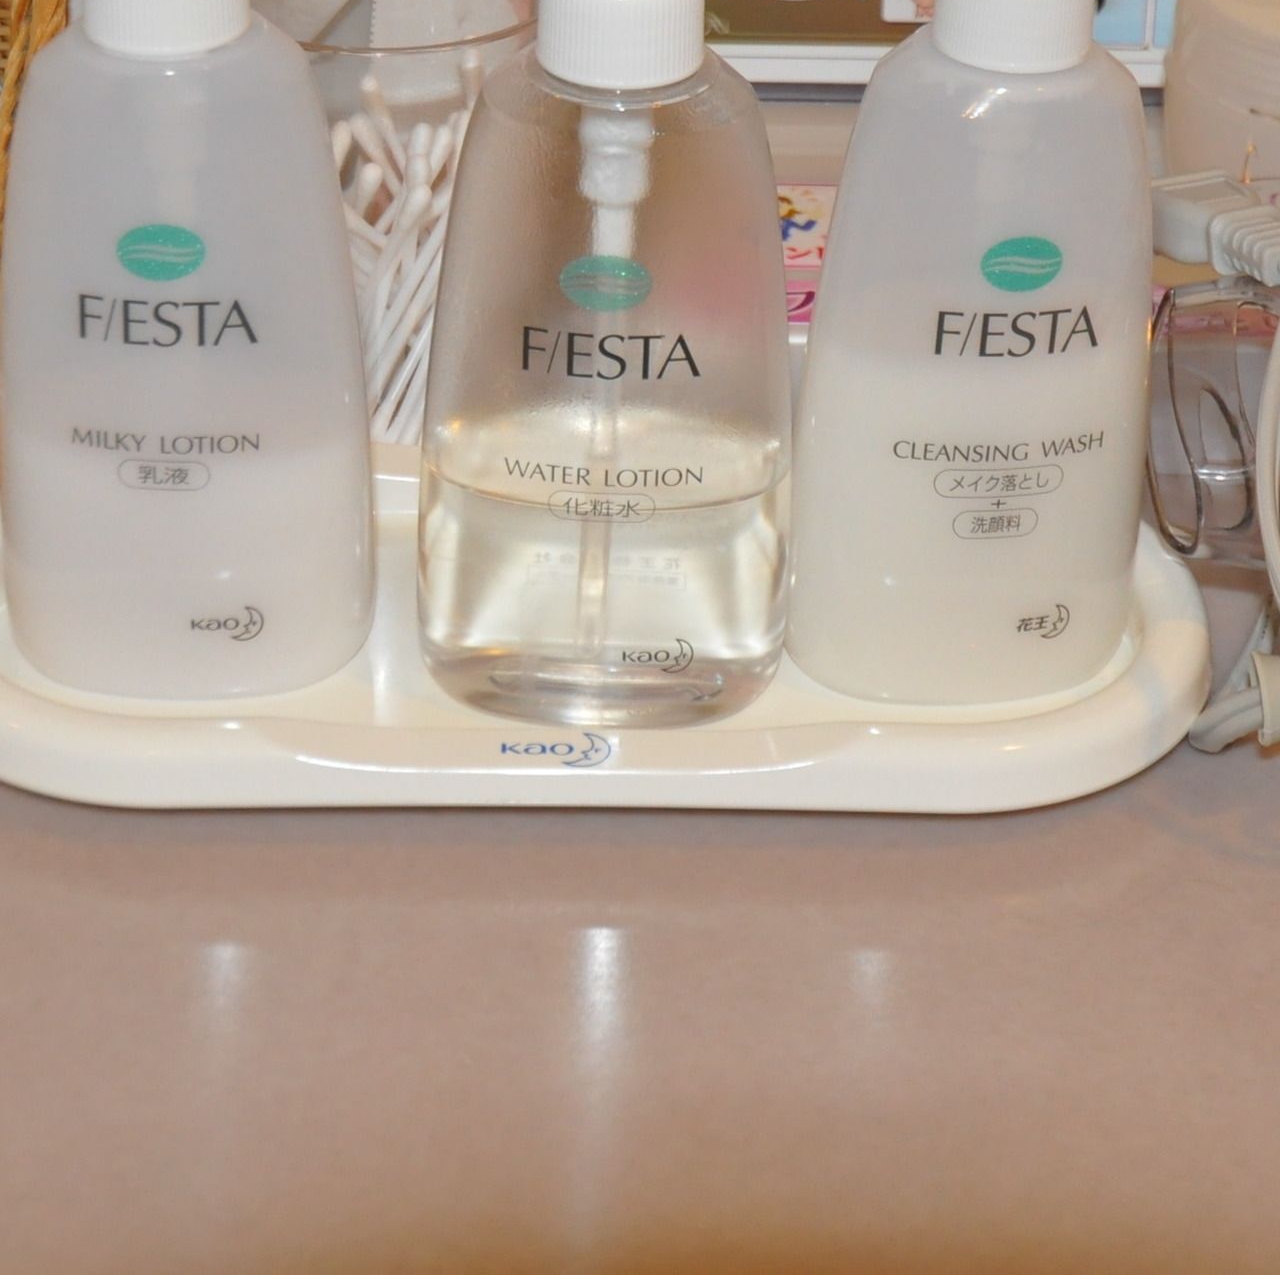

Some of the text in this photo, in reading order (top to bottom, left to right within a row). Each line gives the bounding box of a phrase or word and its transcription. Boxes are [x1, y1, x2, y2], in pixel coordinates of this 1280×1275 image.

[71, 427, 261, 455] MILKY LOTION
[893, 431, 1104, 462] CLEANSING WASH
[137, 465, 190, 485] 乳液
[504, 457, 704, 488] WATER LOTION
[949, 472, 1050, 492] メイク落とし
[562, 497, 641, 518] 化粧水
[970, 515, 1021, 533] 洗顔料
[1017, 615, 1050, 632] 花王
